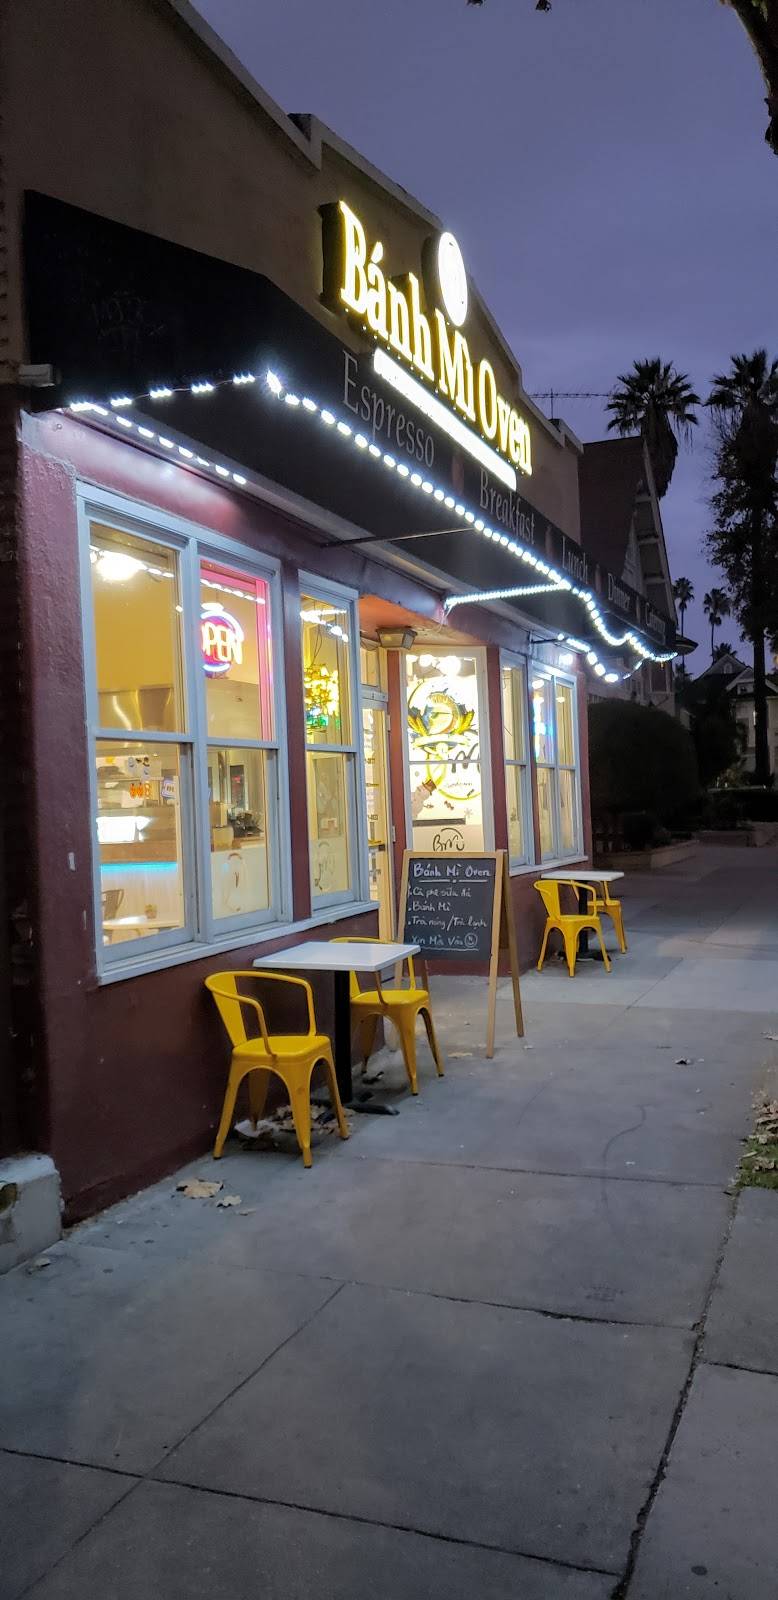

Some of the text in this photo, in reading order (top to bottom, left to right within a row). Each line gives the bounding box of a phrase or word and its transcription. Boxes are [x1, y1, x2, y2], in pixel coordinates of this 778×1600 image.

[338, 199, 434, 382] Bánh
[478, 358, 532, 476] Oven
[342, 350, 436, 468] Espresso
[479, 466, 536, 545] Breakfast
[561, 535, 588, 585] Lunch
[200, 621, 244, 665] PEN
[413, 863, 491, 877] Bánh Mì Oven
